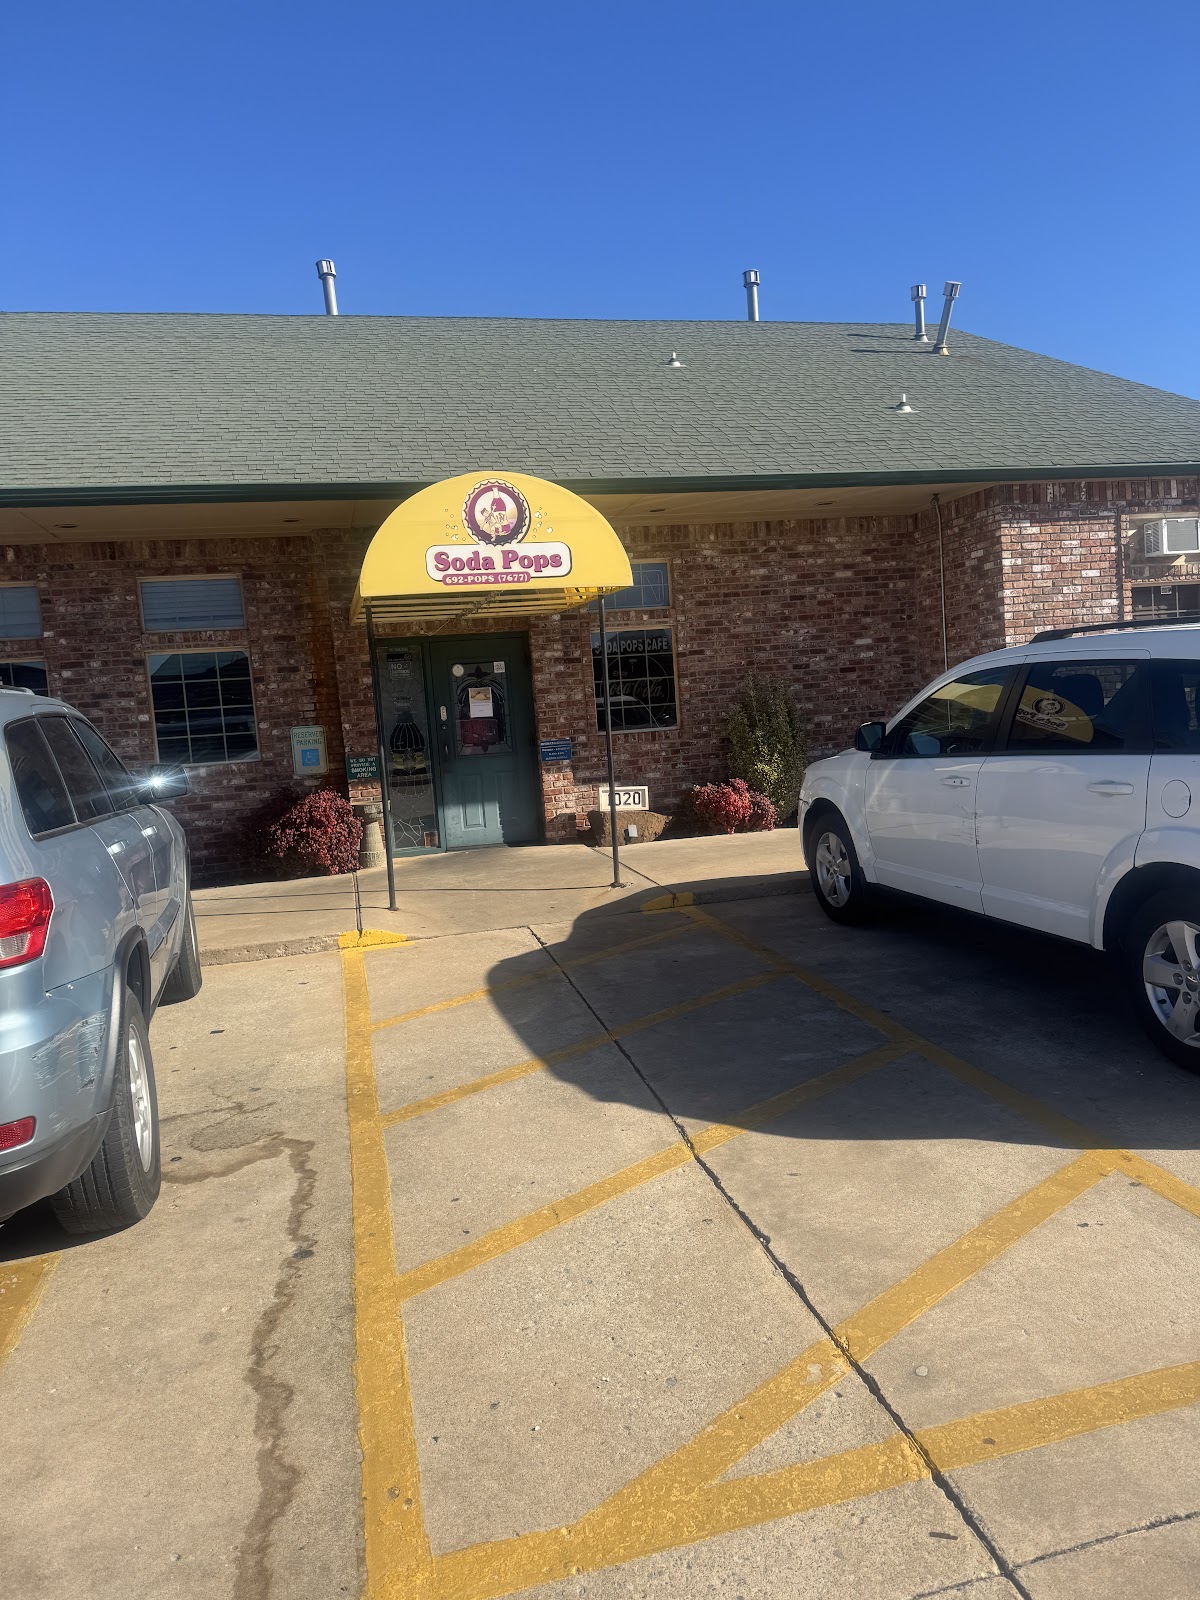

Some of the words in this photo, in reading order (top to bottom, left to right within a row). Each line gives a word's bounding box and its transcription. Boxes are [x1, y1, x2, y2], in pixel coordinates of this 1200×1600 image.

[434, 550, 496, 572] Soda
[501, 549, 563, 573] Pops
[445, 574, 495, 584] 692-POPS
[497, 573, 529, 583] (7677)
[620, 639, 644, 652] POPS
[293, 730, 324, 739] RESERVED
[296, 738, 322, 746] PARKING
[350, 766, 377, 774] SMOKING
